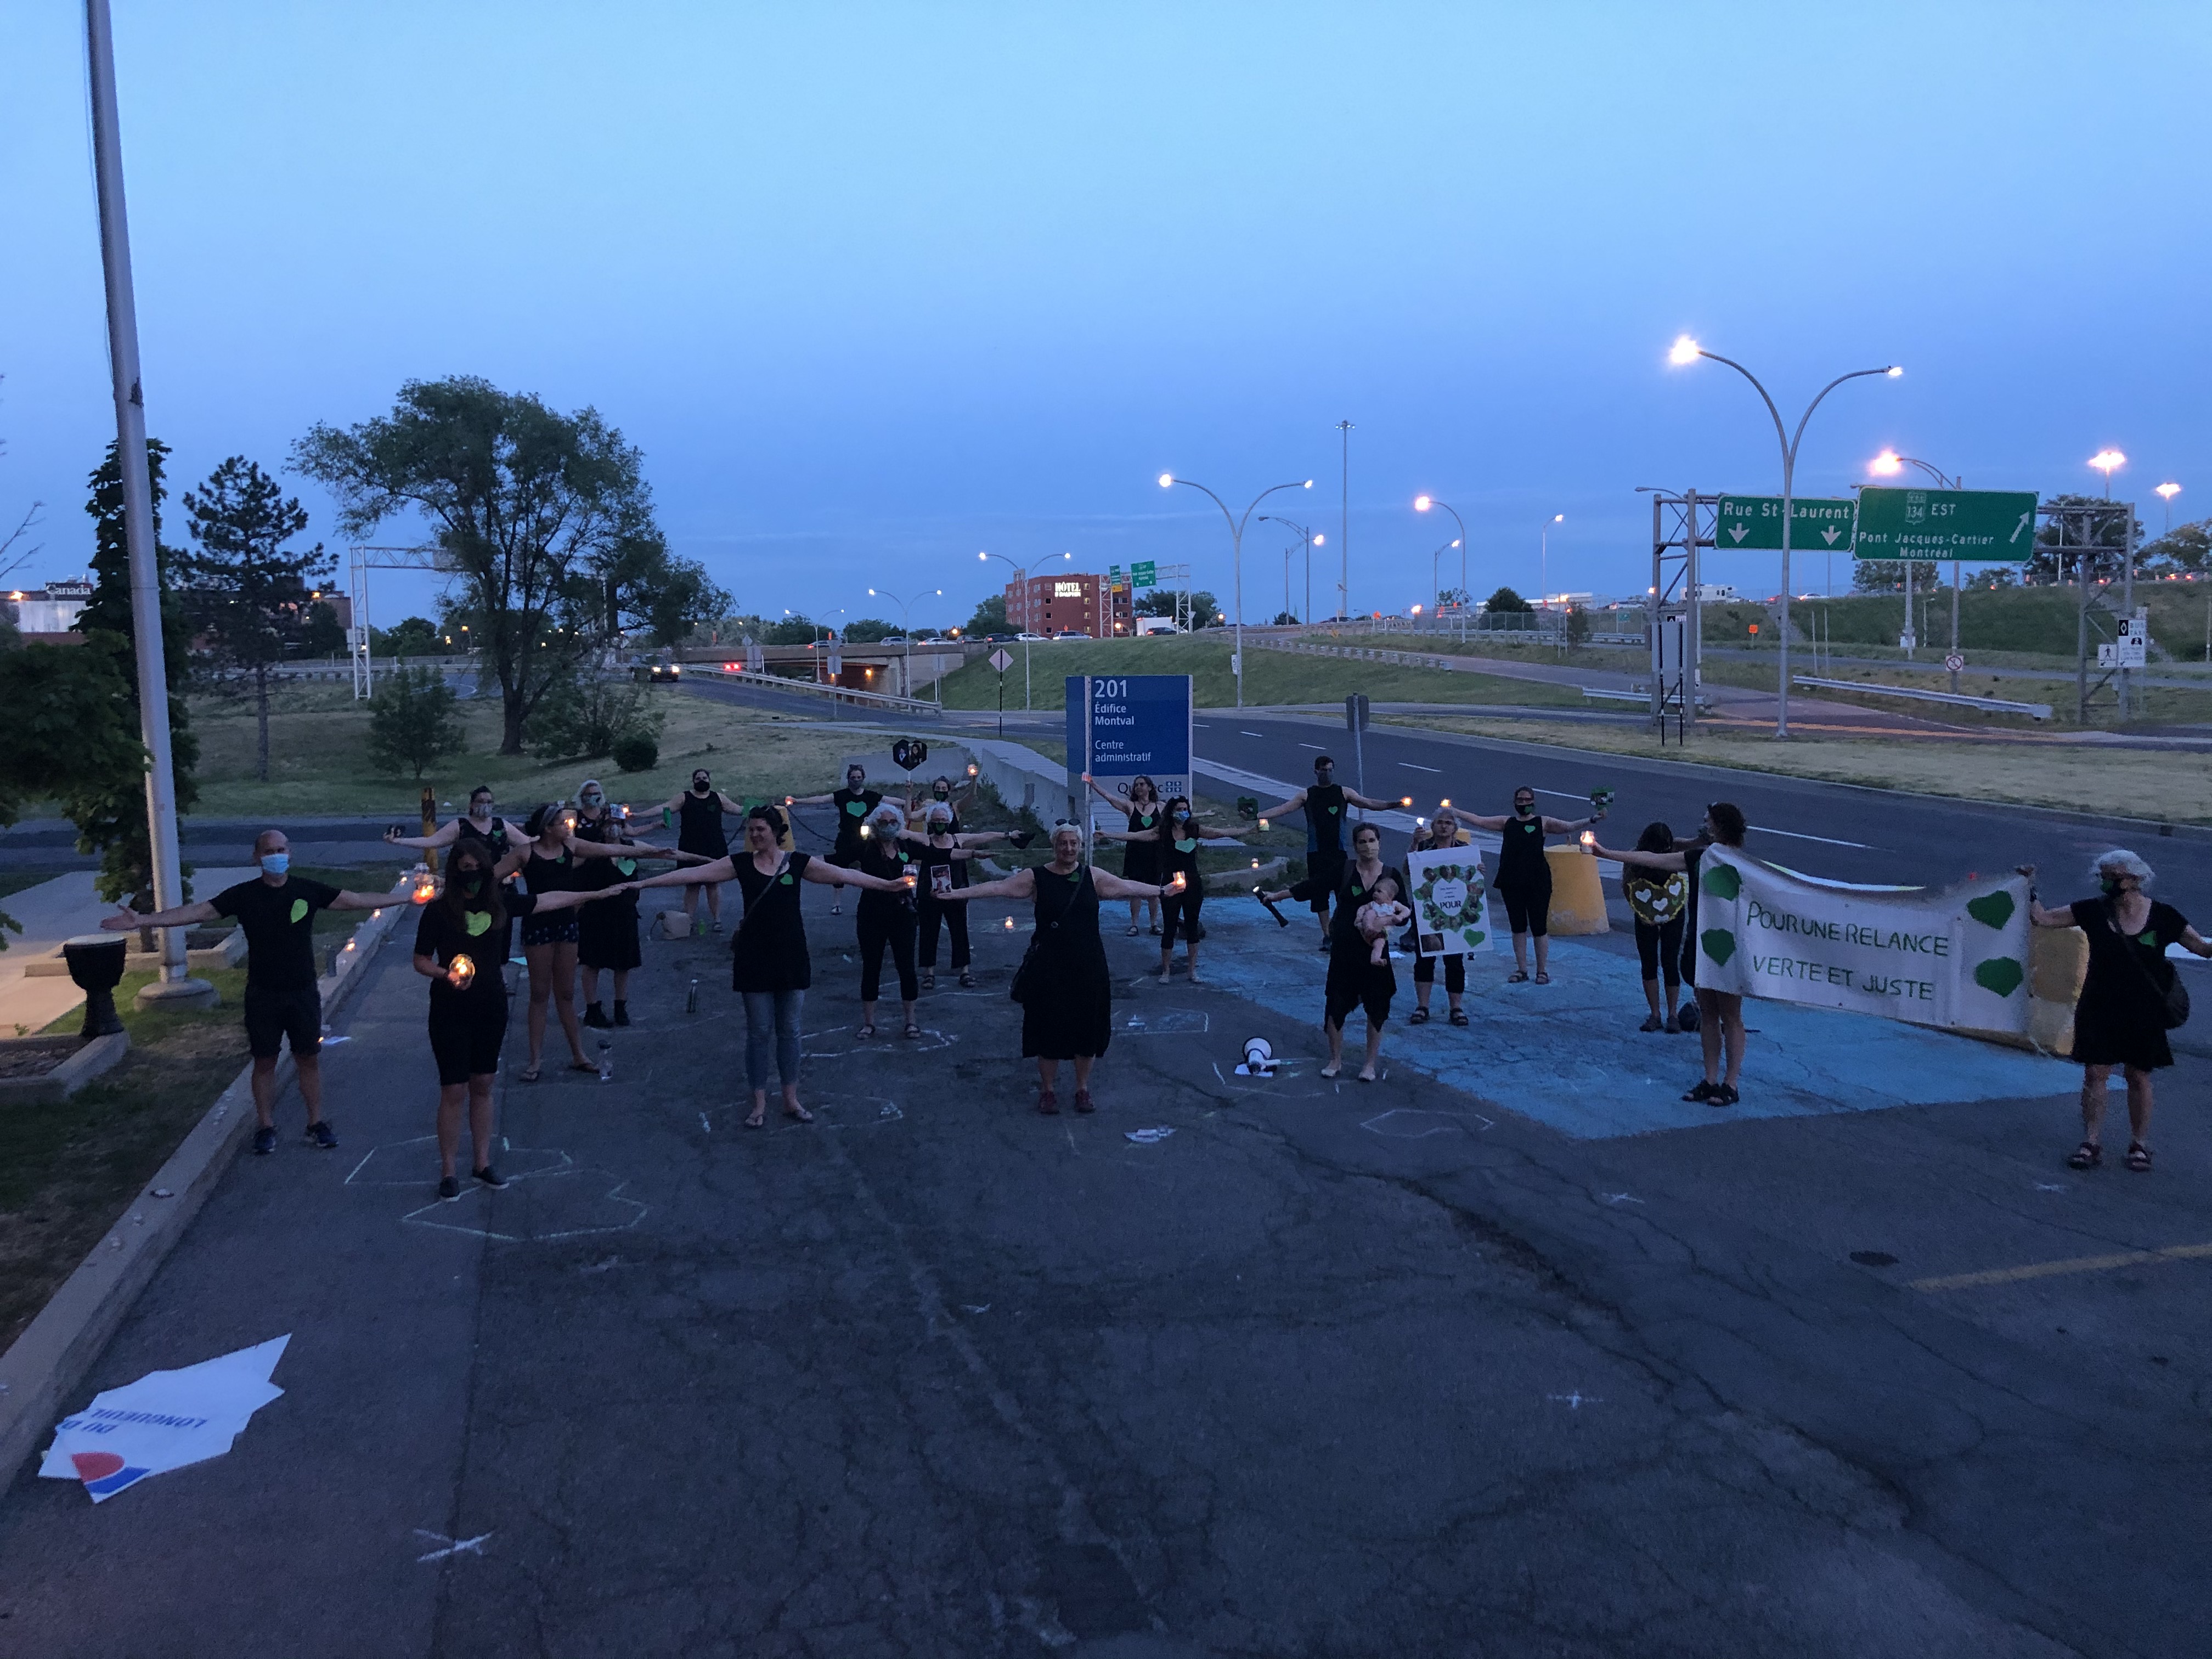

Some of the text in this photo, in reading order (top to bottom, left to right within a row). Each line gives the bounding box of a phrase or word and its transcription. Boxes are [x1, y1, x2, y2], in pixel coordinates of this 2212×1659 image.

[1724, 501, 1752, 517] Rue
[1908, 504, 1956, 517] 134 EST
[1859, 531, 1994, 545] Pont Jacques-Cartier
[1900, 546, 1953, 558] Montréal
[46, 584, 92, 595] Canada
[1055, 581, 1081, 592] HÔTEL
[1095, 679, 1127, 698] 201
[1095, 701, 1126, 713] Édifice
[1095, 715, 1135, 725] Montval
[1095, 740, 1124, 749] Centre
[1094, 752, 1152, 762] administratif
[1440, 900, 1462, 910] POUR
[1747, 900, 1949, 957] POUR UNE RELANCE
[1753, 955, 1934, 1001] VERTE ET JUSTE
